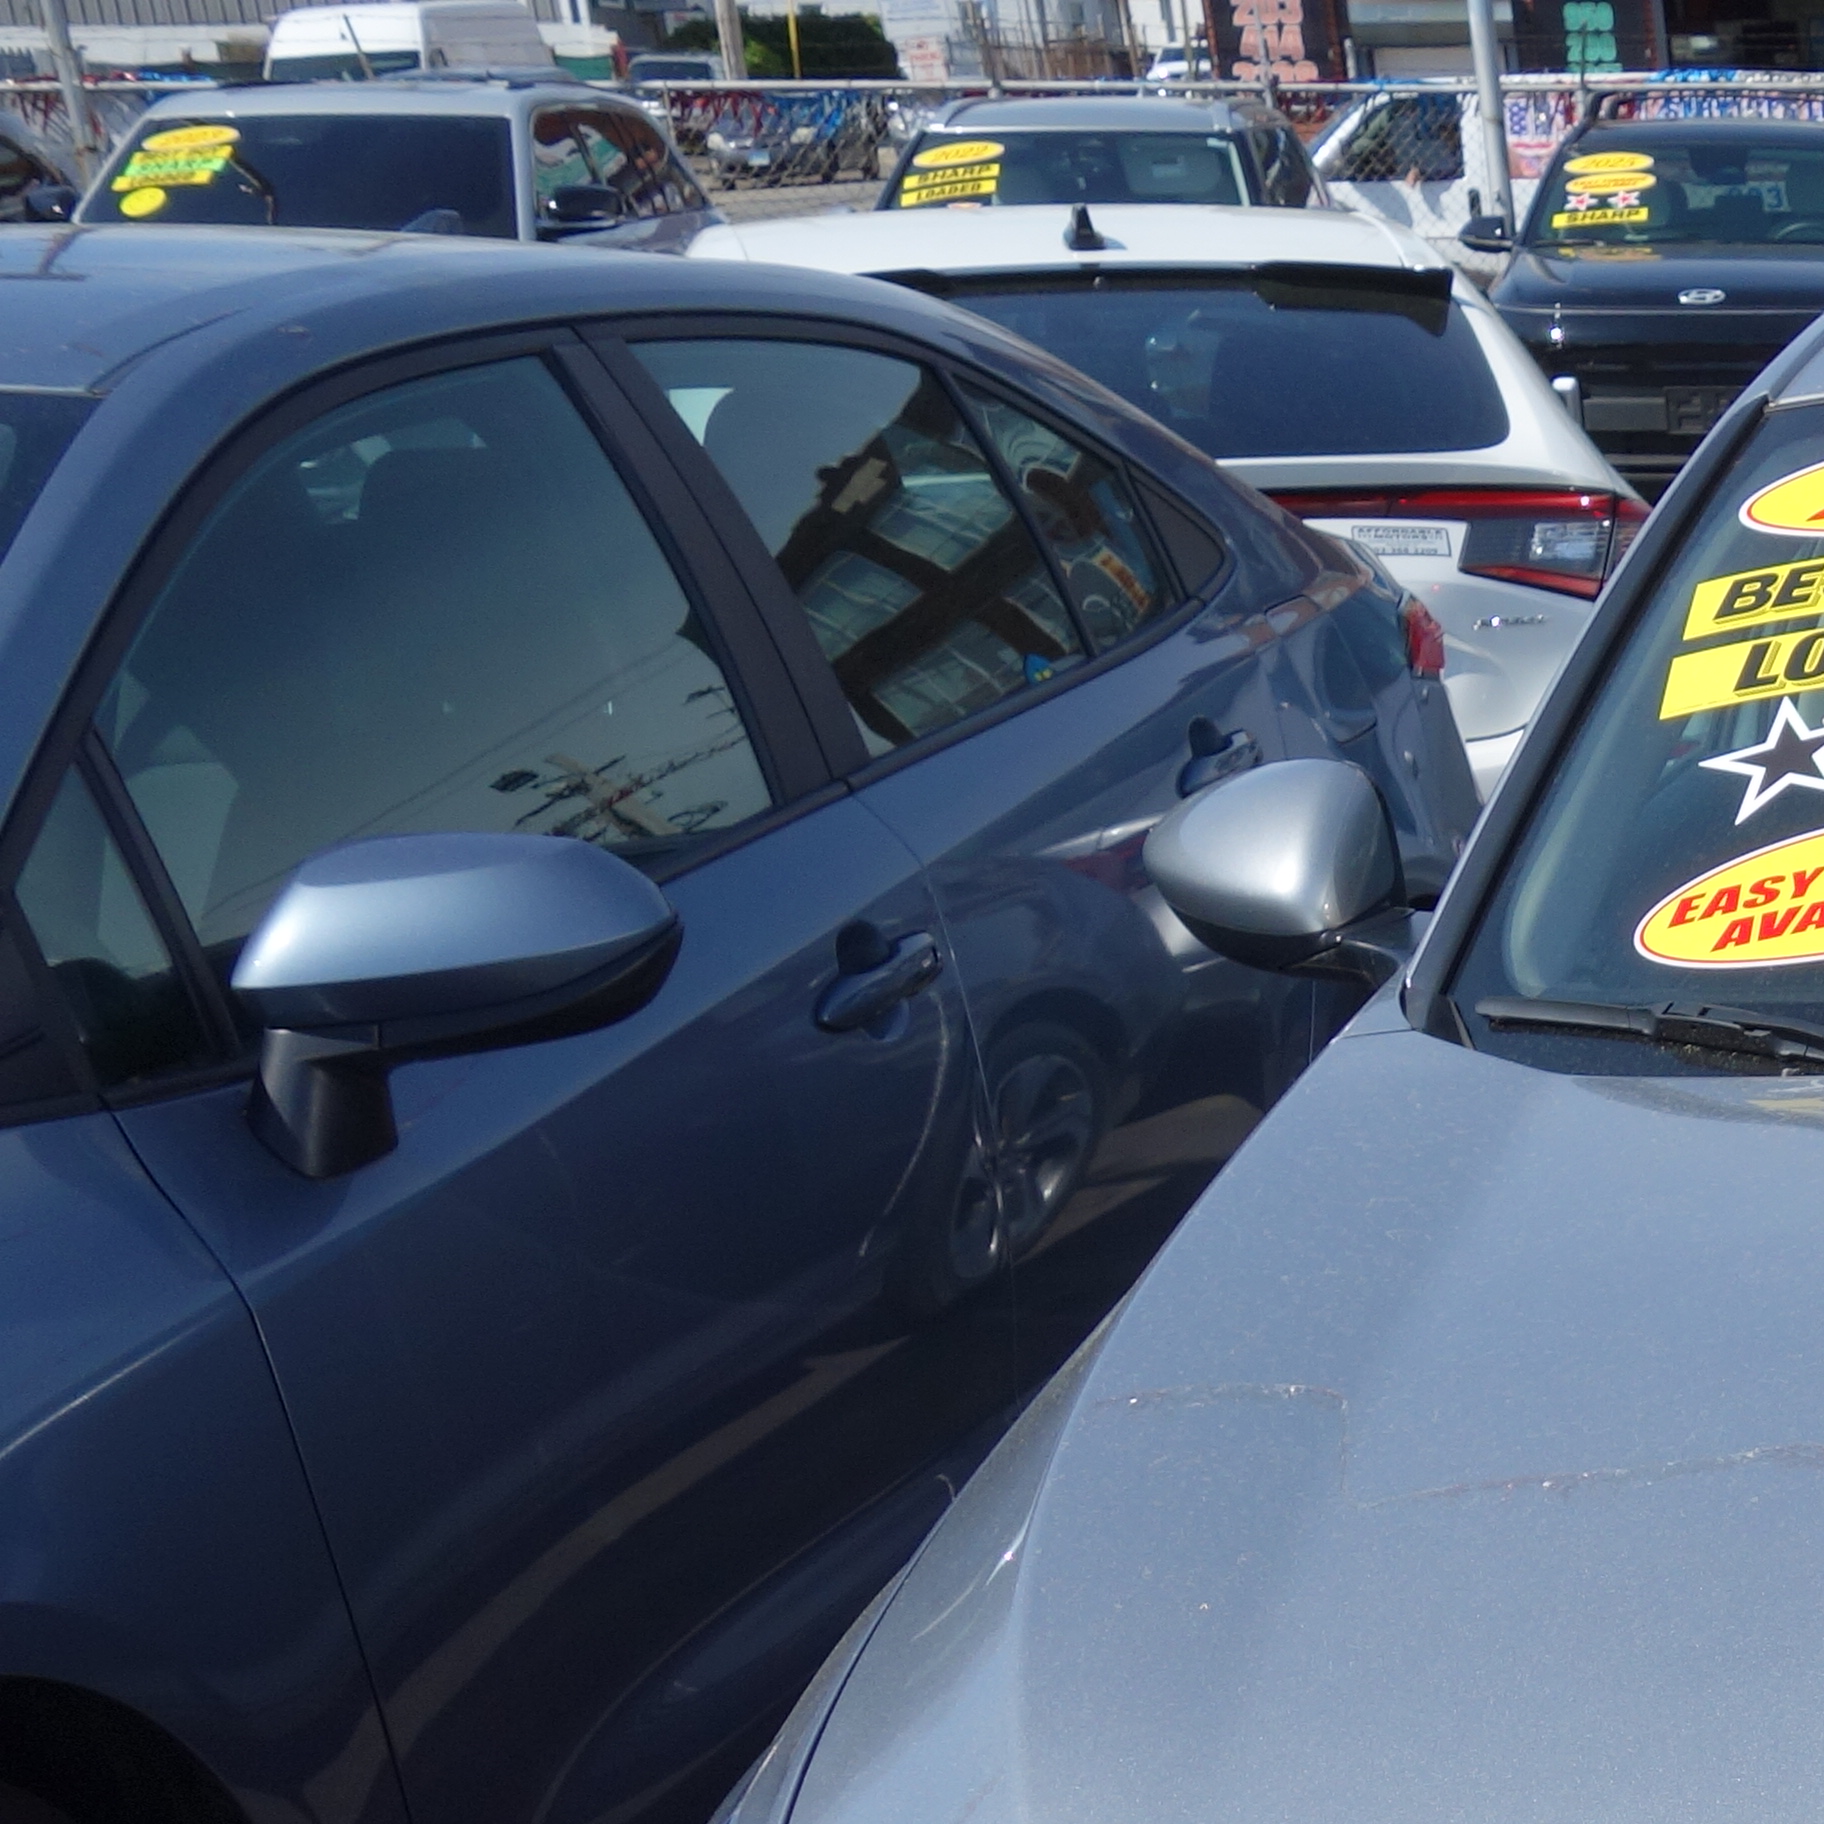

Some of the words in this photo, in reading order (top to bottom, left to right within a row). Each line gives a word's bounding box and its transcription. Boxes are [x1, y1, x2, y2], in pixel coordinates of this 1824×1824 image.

[917, 165, 991, 181] SHARP
[916, 183, 981, 201] LOADED
[1566, 209, 1641, 223] SHARP
